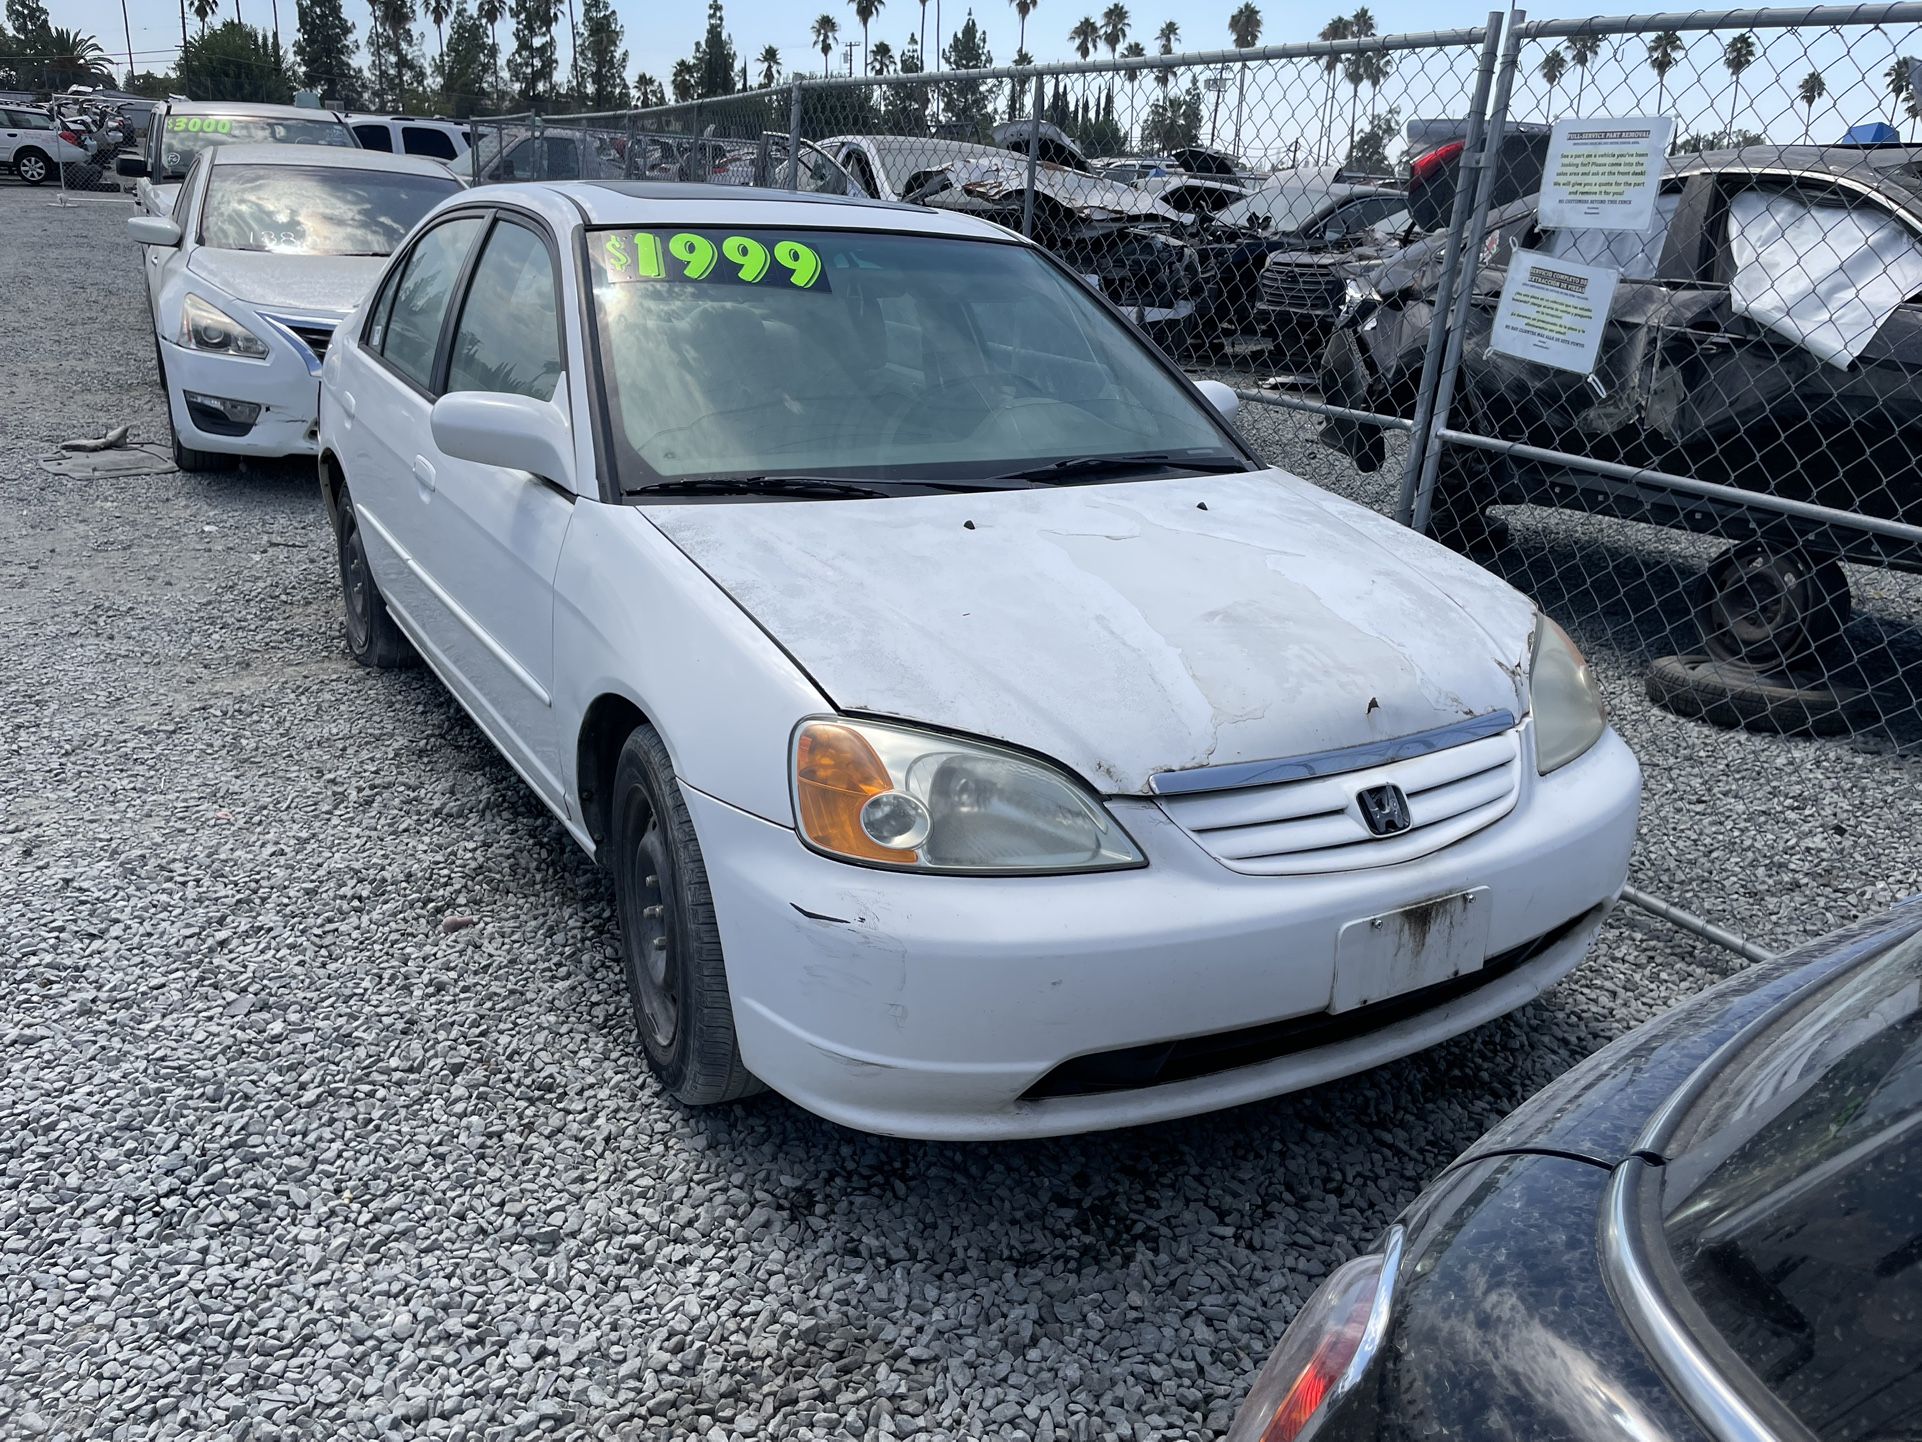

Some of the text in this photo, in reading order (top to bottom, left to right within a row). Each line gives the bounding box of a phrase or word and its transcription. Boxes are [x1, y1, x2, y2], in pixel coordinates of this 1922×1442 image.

[168, 117, 230, 133] $3000
[1567, 132, 1605, 140] FULL-SERVICE
[1622, 130, 1650, 138] REMOVAL
[1616, 152, 1634, 160] you've
[606, 232, 822, 289] $1999
[1553, 273, 1580, 285] COMPLETO
[1567, 284, 1585, 293] PIEZAS
